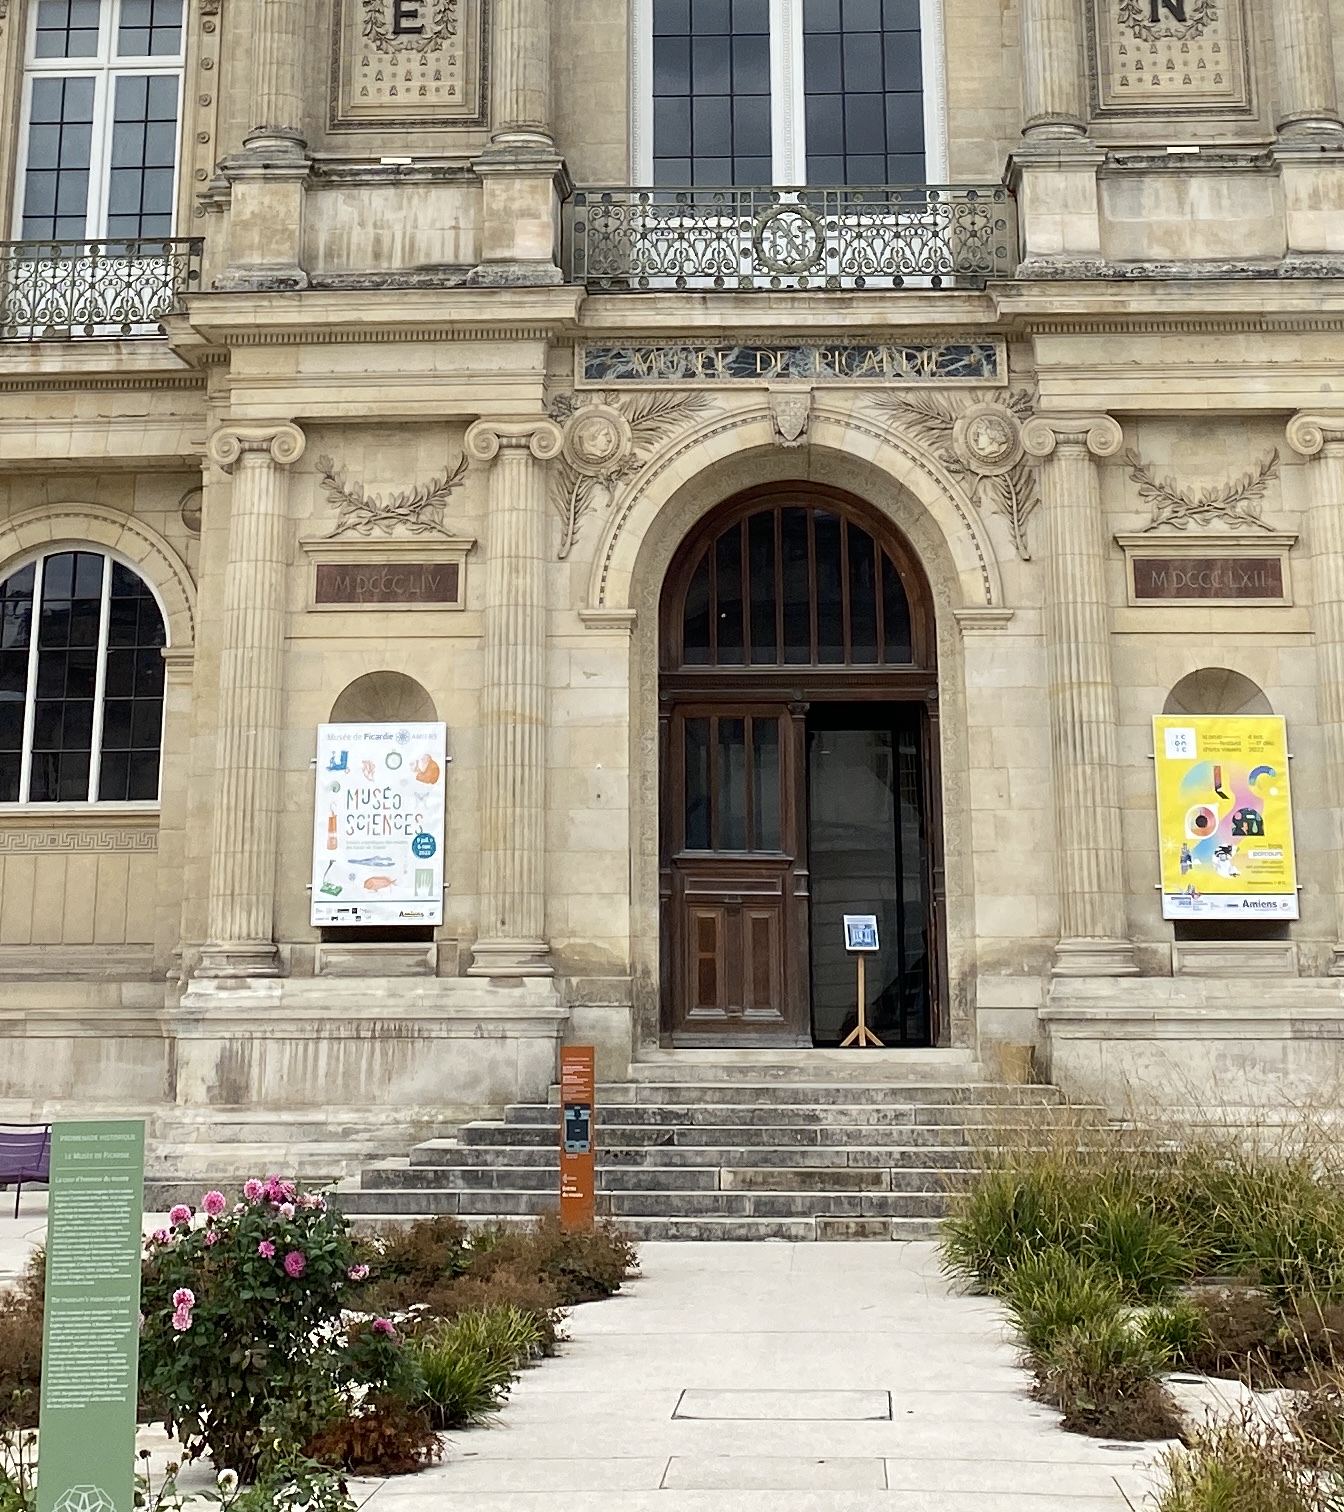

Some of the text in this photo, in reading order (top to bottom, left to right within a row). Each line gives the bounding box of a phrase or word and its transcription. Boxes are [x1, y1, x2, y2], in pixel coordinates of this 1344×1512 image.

[756, 350, 790, 374] DE
[364, 732, 394, 740] Picardie
[1243, 899, 1277, 908] Amiens
